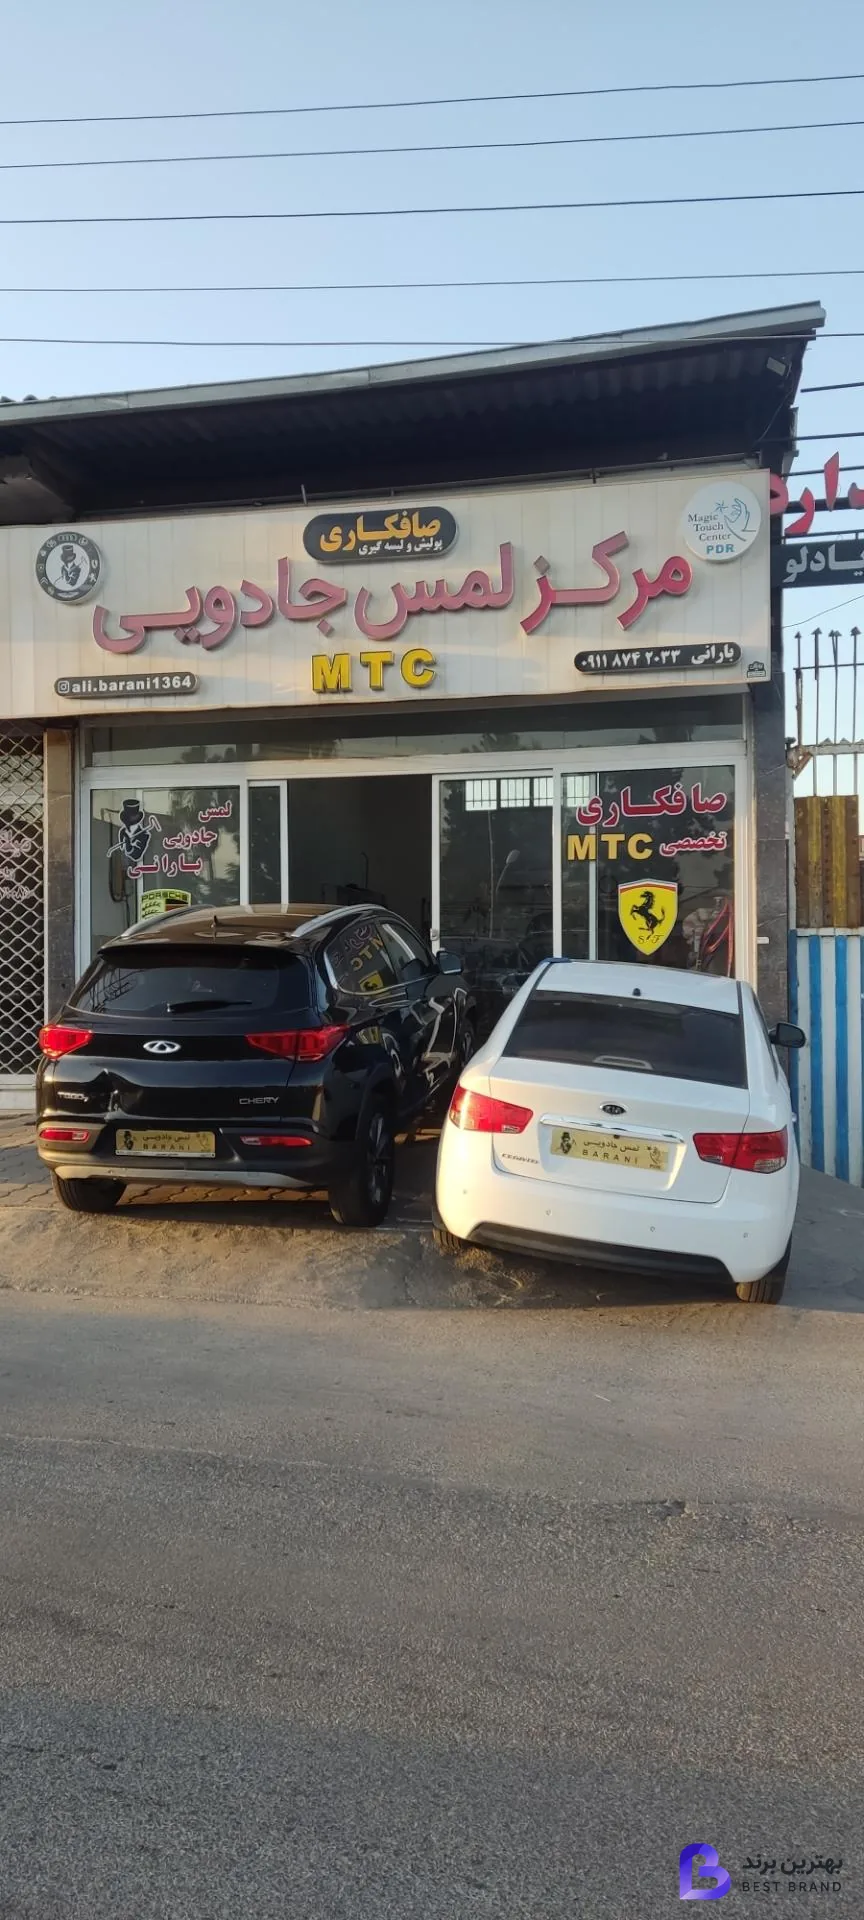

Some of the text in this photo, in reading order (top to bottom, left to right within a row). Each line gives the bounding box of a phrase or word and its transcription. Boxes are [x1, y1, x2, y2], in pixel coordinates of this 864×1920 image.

[688, 513, 719, 523] Magic
[693, 522, 724, 532] Touch
[319, 510, 441, 552] صافکاری
[699, 533, 731, 542] Center
[358, 536, 443, 556] پولیش و لیسه گیری
[706, 544, 735, 554] PDR
[92, 530, 693, 654] مرکز لمس جادویی
[582, 643, 734, 668] بارانی ۰۹۱۱ ۸۷۴ ۲۰۳۳
[311, 648, 436, 693] MTC
[198, 800, 232, 822] لمس
[576, 782, 727, 827] صافکاری
[163, 827, 218, 849] جادویی
[567, 831, 728, 861] تخصصی MTC
[127, 853, 203, 879] بارانی
[239, 1096, 280, 1105] CHERY
[582, 1149, 638, 1164] BARANI
